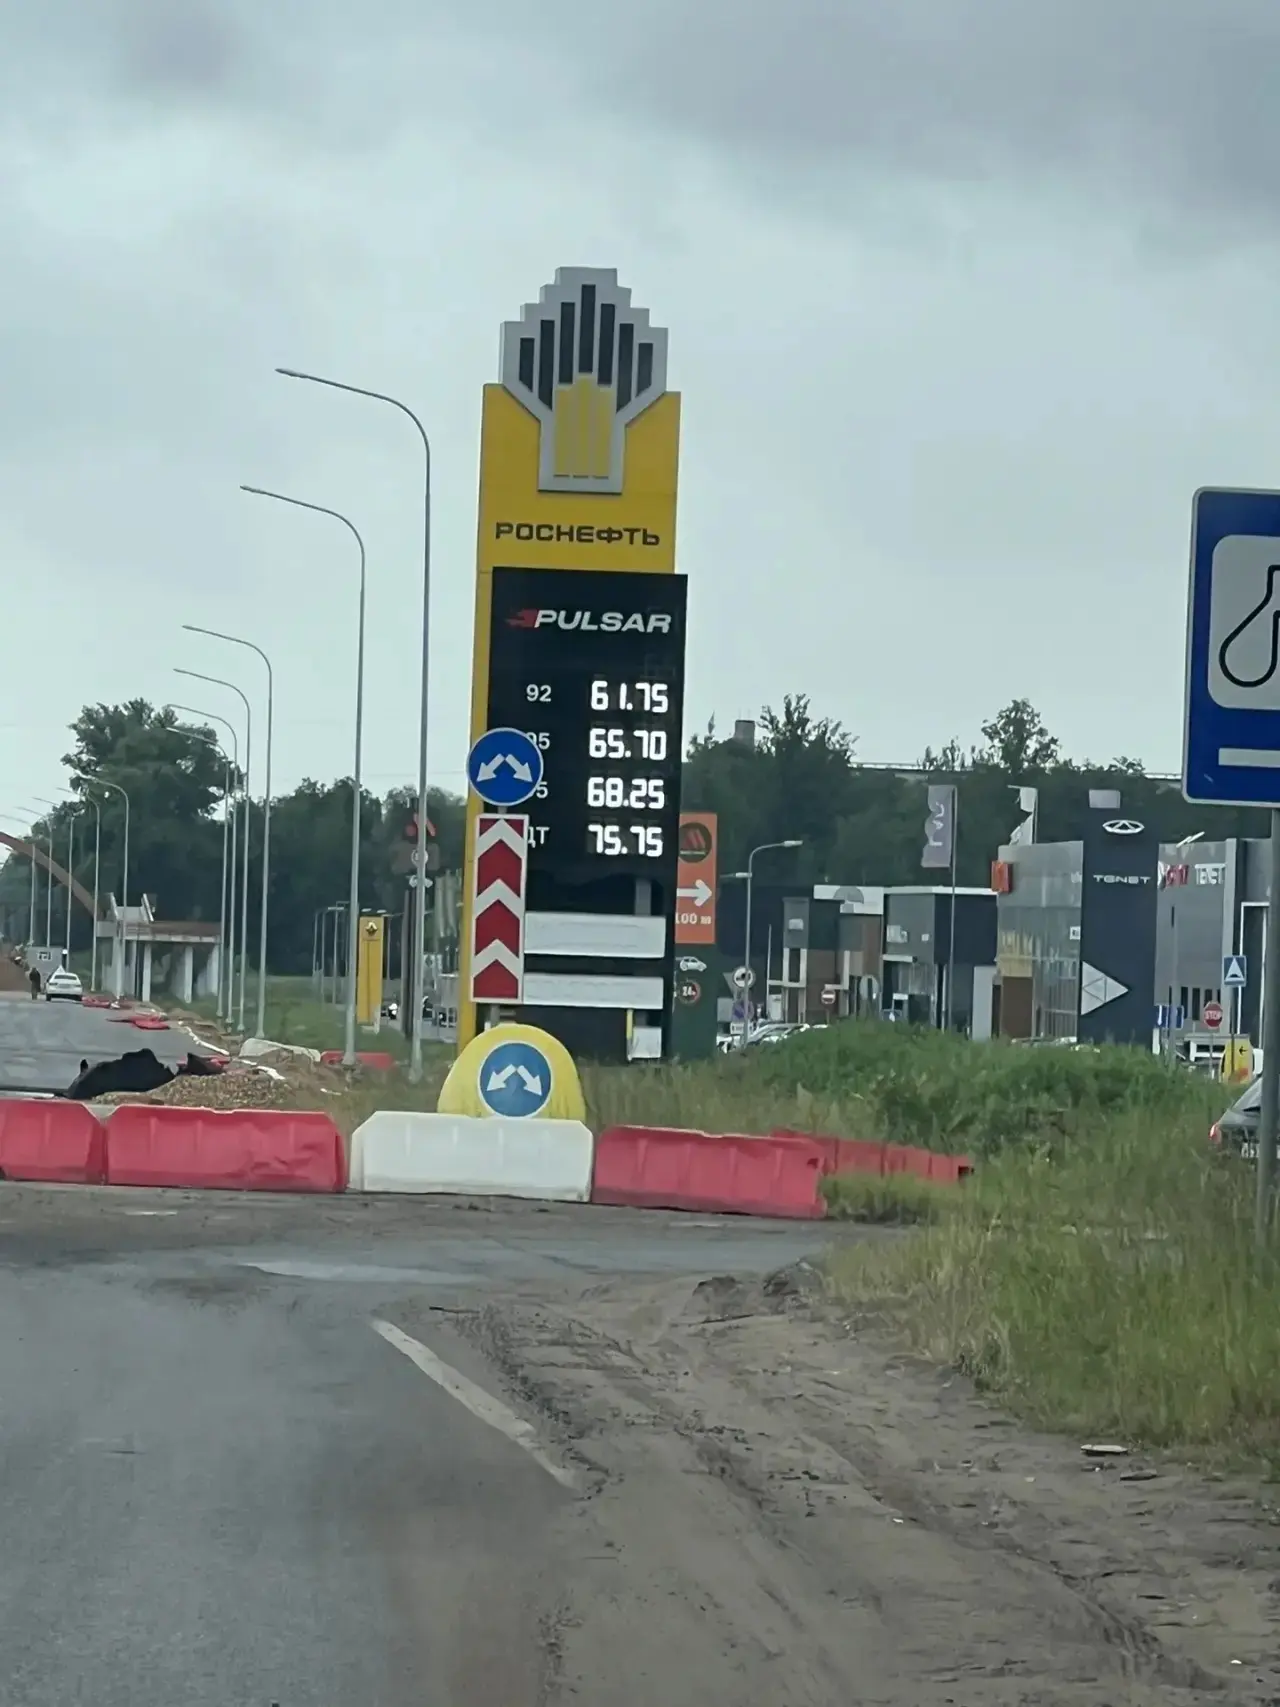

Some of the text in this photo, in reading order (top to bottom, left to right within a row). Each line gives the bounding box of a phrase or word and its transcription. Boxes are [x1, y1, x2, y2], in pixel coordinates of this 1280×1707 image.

[495, 522, 660, 546] РОСНЕФТЬ
[534, 609, 673, 634] PULSAR
[526, 680, 669, 713] 92 61.75
[588, 727, 667, 760] 65.70
[587, 776, 665, 810] 68.25
[587, 824, 664, 858] 75.75
[1092, 873, 1152, 885] TENET
